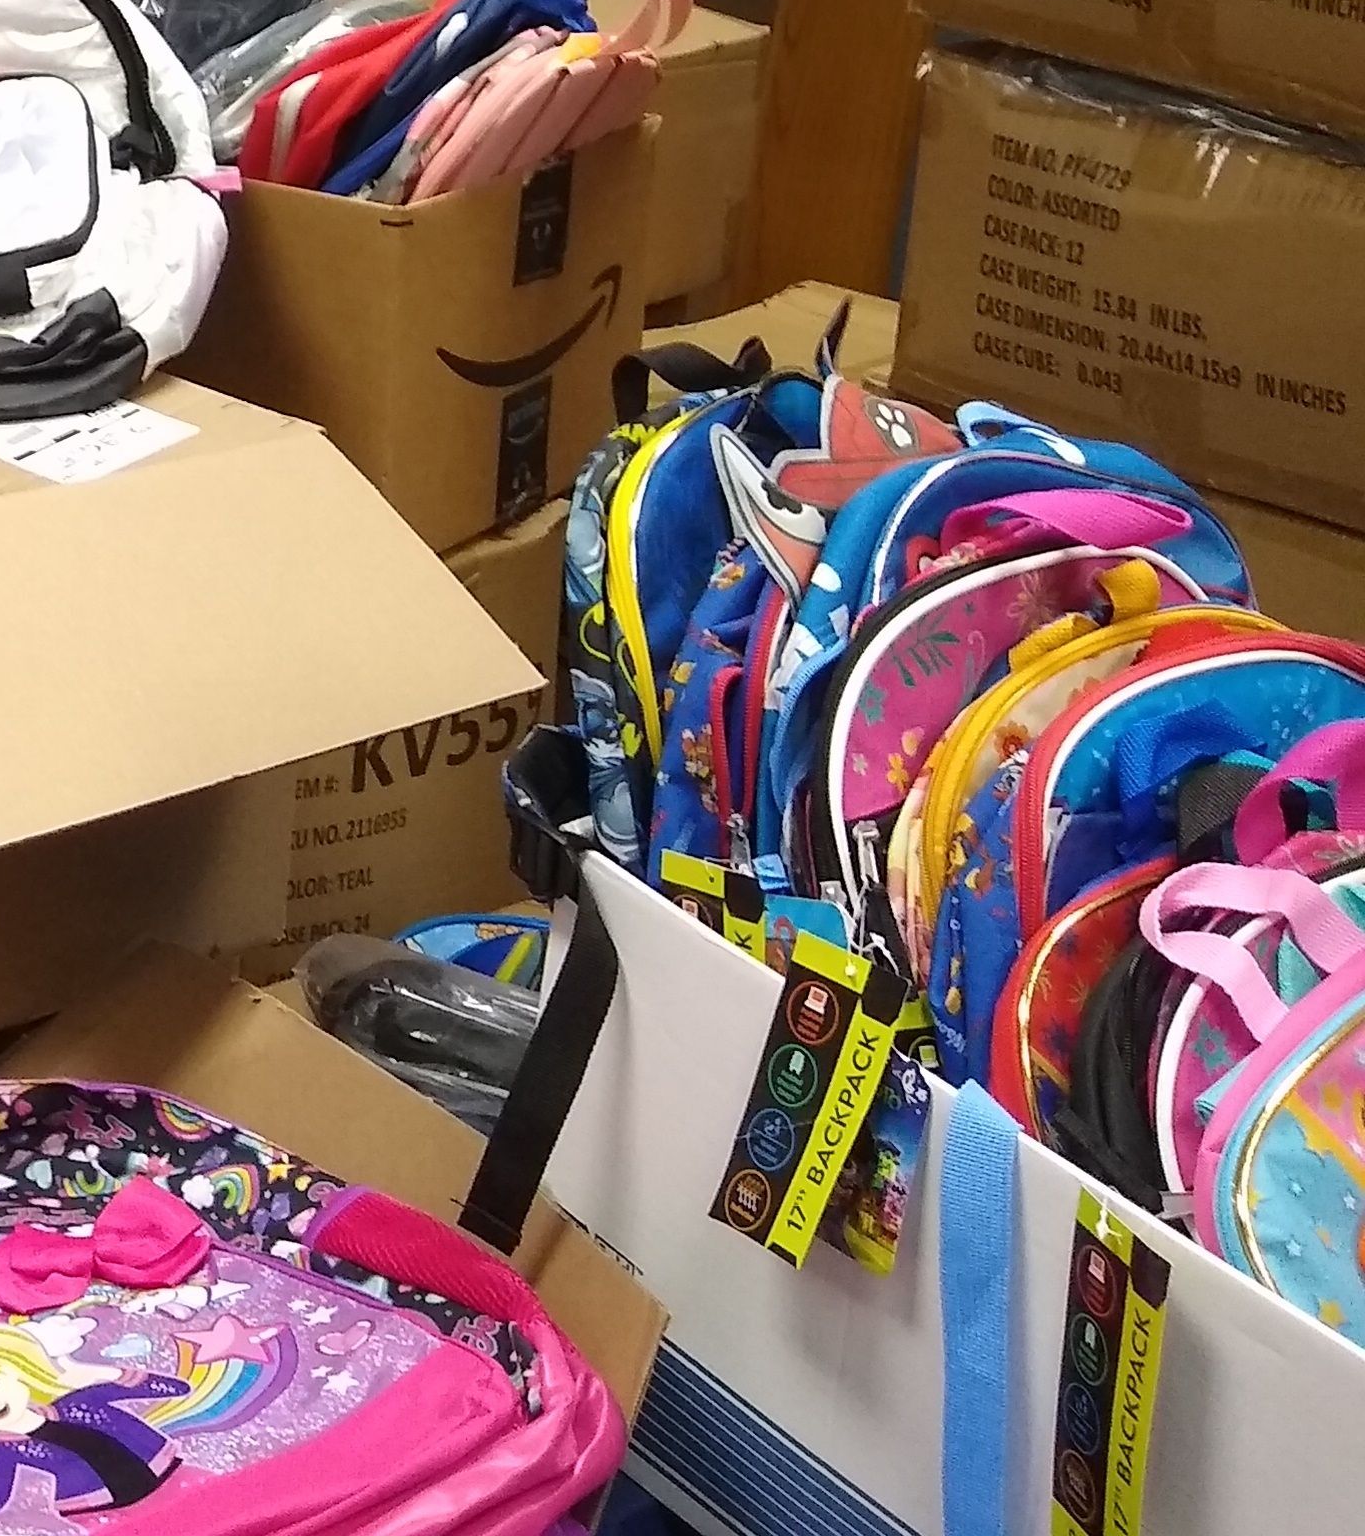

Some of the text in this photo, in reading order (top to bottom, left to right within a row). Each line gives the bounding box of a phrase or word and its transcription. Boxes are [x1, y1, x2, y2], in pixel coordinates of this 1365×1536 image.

[992, 134, 1133, 192] ITEM NO. PY-4729
[987, 173, 1122, 232] COLOR: ASSORTED
[983, 214, 1085, 266] CASE PACK: 12
[979, 253, 1208, 341] CASE WEIGHT: 15.84 IN LBS.
[973, 332, 1124, 396] CASE CUBE: 0.043
[975, 293, 1347, 416] CASE DIMENSION: 20.44x14.15x9 IN INCHES
[313, 824, 343, 846] NO.
[337, 864, 374, 892] TEAL
[787, 1188, 807, 1232] 17"
[806, 1028, 881, 1187] BACKPACK
[1116, 1309, 1151, 1488] BACKPACK
